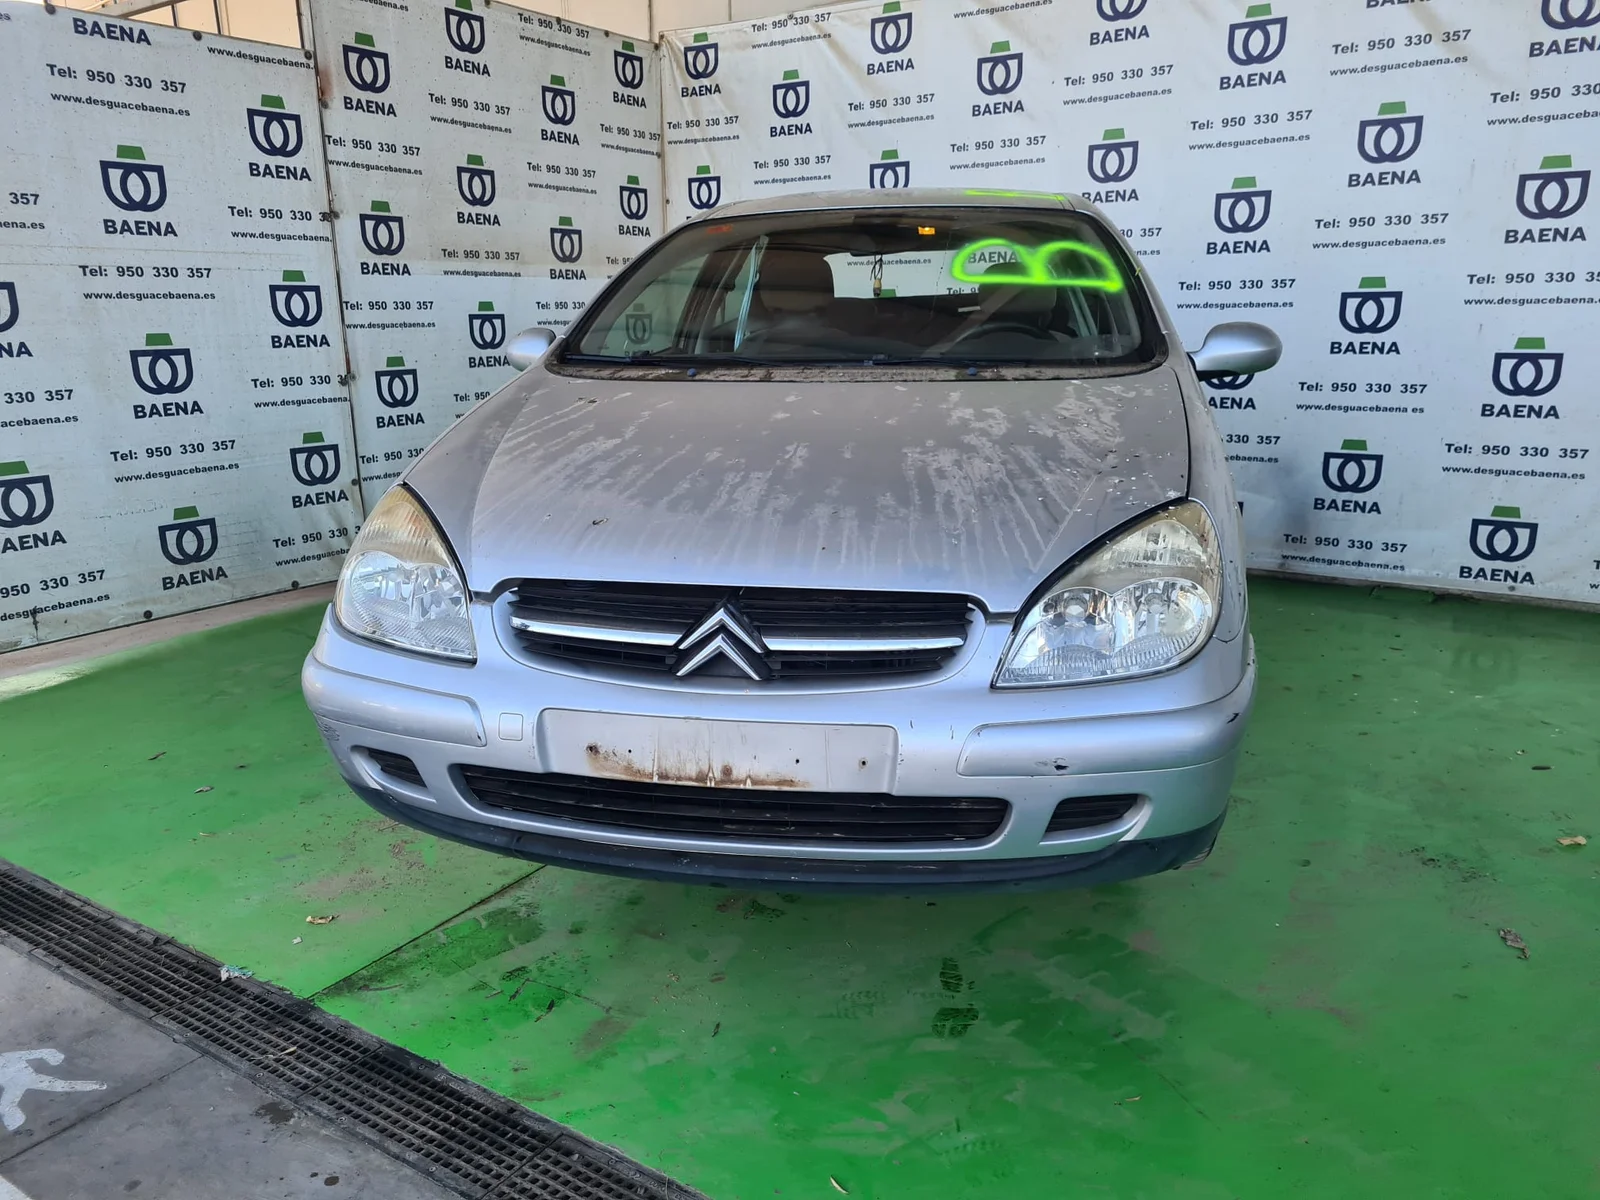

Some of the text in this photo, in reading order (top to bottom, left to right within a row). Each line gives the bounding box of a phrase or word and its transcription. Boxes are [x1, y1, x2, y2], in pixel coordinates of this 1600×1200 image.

[517, 12, 589, 39] Tel: 950 330 357
[751, 12, 832, 32] Tel: 950 330 357
[72, 17, 152, 46] BAENA
[1090, 25, 1150, 46] BAENA
[1332, 29, 1471, 54] Tel: 950 330 357
[444, 55, 491, 77] BAENA
[867, 58, 915, 75] BAENA
[1330, 56, 1468, 76] www.desguacebaena.es
[46, 63, 186, 93] Tel: 950 330 357
[1064, 64, 1174, 86] Tel: 950 330 357
[1219, 70, 1286, 90] BAENA
[681, 83, 721, 98] BAENA
[1063, 88, 1172, 106] www.desguacebaena.es
[1490, 83, 1600, 103] Tel: 950 330
[50, 93, 190, 116] www.desguacebaena.es
[343, 96, 397, 117] BAENA
[428, 93, 510, 116] Tel: 950 330 357
[613, 91, 647, 109] BAENA
[848, 93, 935, 111] Tel: 950 330 357
[972, 100, 1025, 117] BAENA
[430, 116, 512, 134] www.desguacebaena.es
[667, 115, 739, 130] Tel: 950 330 357
[847, 114, 934, 129] www.desguacebaena.es
[1190, 109, 1313, 130] Tel: 950 330 357
[541, 129, 580, 146] BAENA
[770, 123, 812, 138] BAENA
[325, 134, 420, 156] Tel: 950 330 357
[950, 135, 1046, 153] Tel: 950 330 357
[1189, 134, 1310, 150] www.desguacebaena.es
[327, 158, 423, 176] www.desguacebaena.es
[527, 162, 596, 178] Tel: 950 330 357
[753, 155, 831, 169] Tel: 950 330 357
[949, 157, 1045, 170] www.desguacebaena.es
[249, 162, 312, 181] BAENA
[754, 174, 831, 185] www.desguacebaena.es
[1348, 169, 1421, 188] BAENA
[457, 211, 501, 226] BAENA
[1315, 213, 1449, 229] Tel: 950 330 357
[103, 219, 178, 237] BAENA
[618, 224, 651, 237] BAENA
[1504, 227, 1586, 244] BAENA
[1206, 240, 1271, 255] BAENA
[1312, 238, 1446, 249] www.desguacebaena.es
[441, 248, 520, 261] Tel: 950 330 357
[78, 265, 211, 278] Tel: 950 330 357
[360, 262, 411, 276] BAENA
[443, 269, 521, 278] www.desguacebaena.es
[550, 268, 586, 280] BAENA
[1178, 279, 1296, 291] Tel: 950 330 357
[1467, 272, 1575, 284] Tel: 950 330
[83, 291, 216, 301] www.desguacebaena.es
[342, 300, 434, 311] Tel: 950 330 357
[1177, 301, 1294, 310] www.desguacebaena.es
[345, 321, 436, 330] www.desguacebaena.es
[271, 334, 330, 349] BAENA
[1330, 341, 1400, 355] BAENA
[468, 355, 510, 368] BAENA
[4, 389, 73, 404] 330 357
[1298, 382, 1427, 394] Tel: 950 330 357
[133, 400, 204, 419] BAENA
[1481, 403, 1560, 419] BAENA
[376, 412, 425, 429] BAENA
[1226, 434, 1281, 445] 330 357
[110, 439, 235, 462] Tel: 950 330 357
[1445, 443, 1589, 459] Tel: 950 330 357
[114, 463, 239, 483] www.desguacebaena.es
[1442, 466, 1585, 480] www.desguacebaena.es
[292, 489, 349, 509] BAENA
[1313, 497, 1381, 514] BAENA
[1283, 534, 1407, 553] Tel: 950 330 357
[1281, 552, 1405, 572] www.desguacebaena.es
[0, 569, 105, 598] 950 330 357
[162, 566, 228, 591] BAENA
[1459, 566, 1535, 585] BAENA
